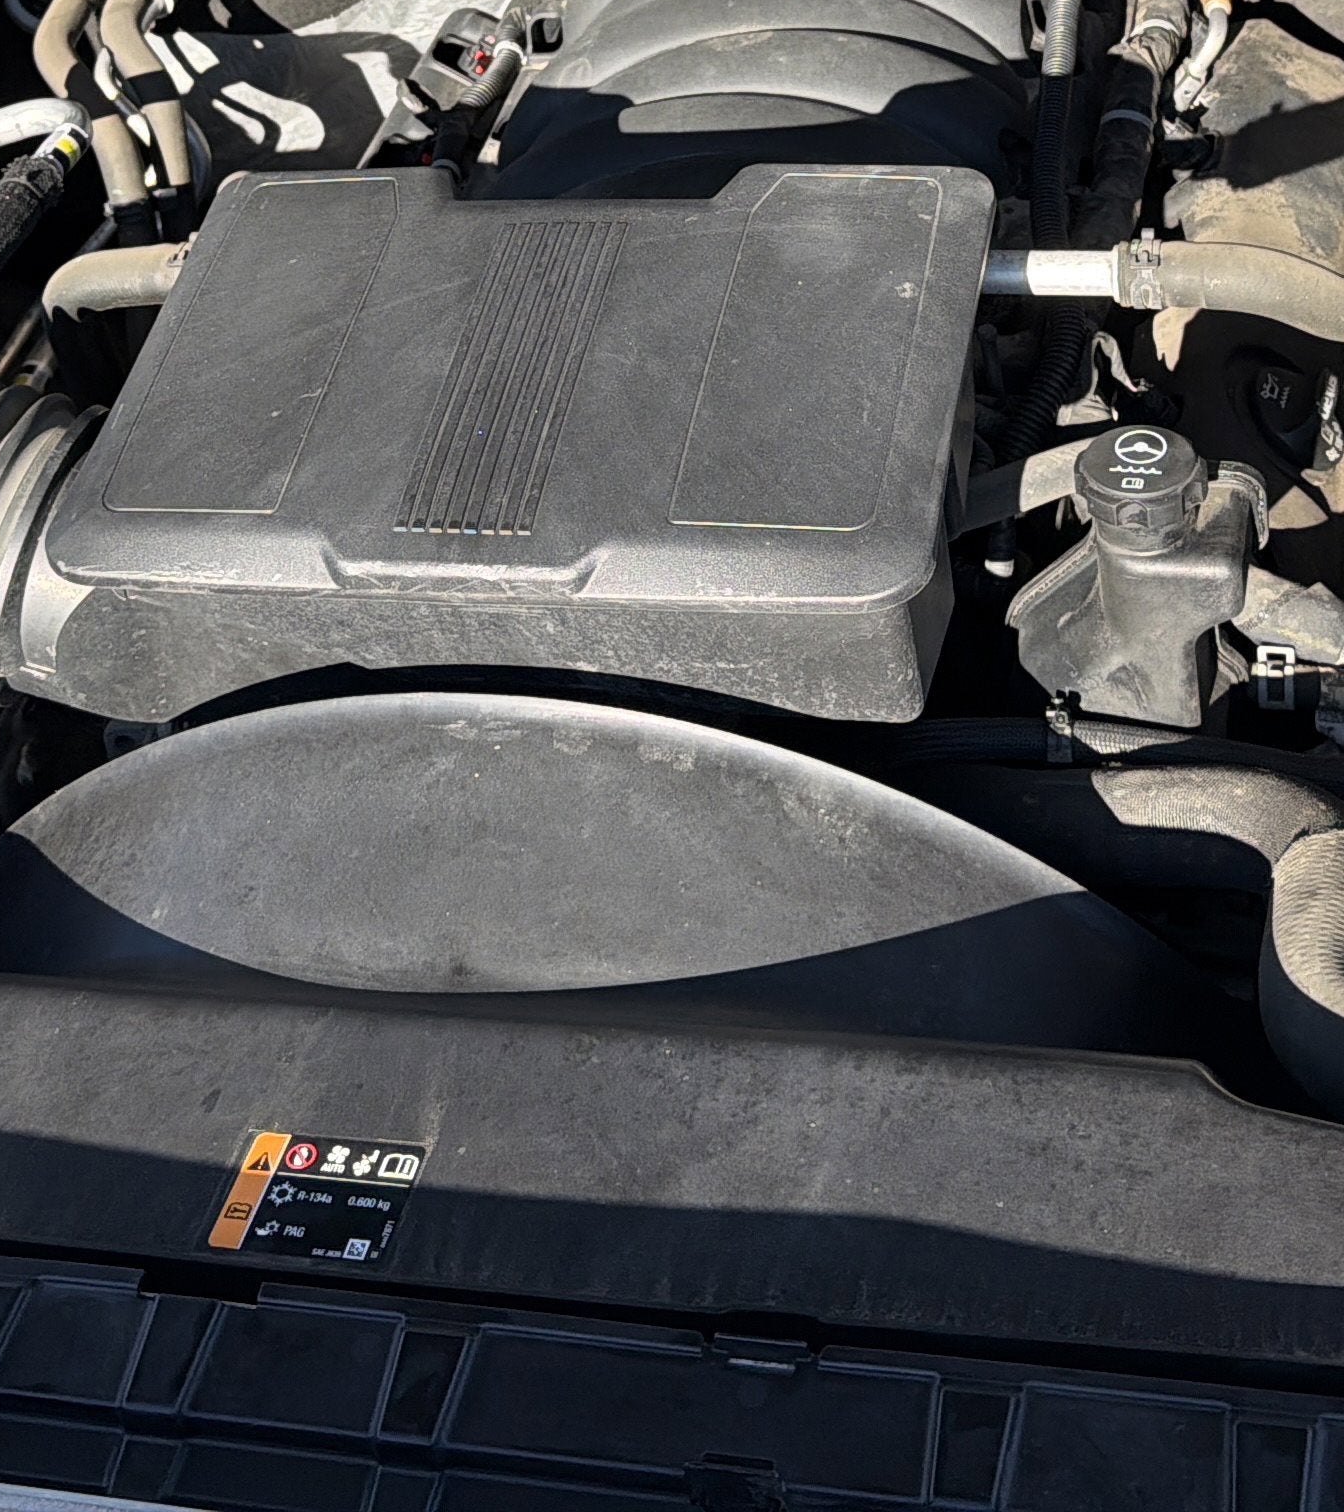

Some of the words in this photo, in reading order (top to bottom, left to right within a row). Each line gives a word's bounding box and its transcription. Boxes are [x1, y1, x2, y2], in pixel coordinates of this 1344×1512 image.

[320, 1162, 346, 1174] AUTO
[296, 1190, 333, 1205] R-134a
[347, 1195, 377, 1209] 0.600
[377, 1199, 391, 1212] kg
[283, 1225, 307, 1238] PAG
